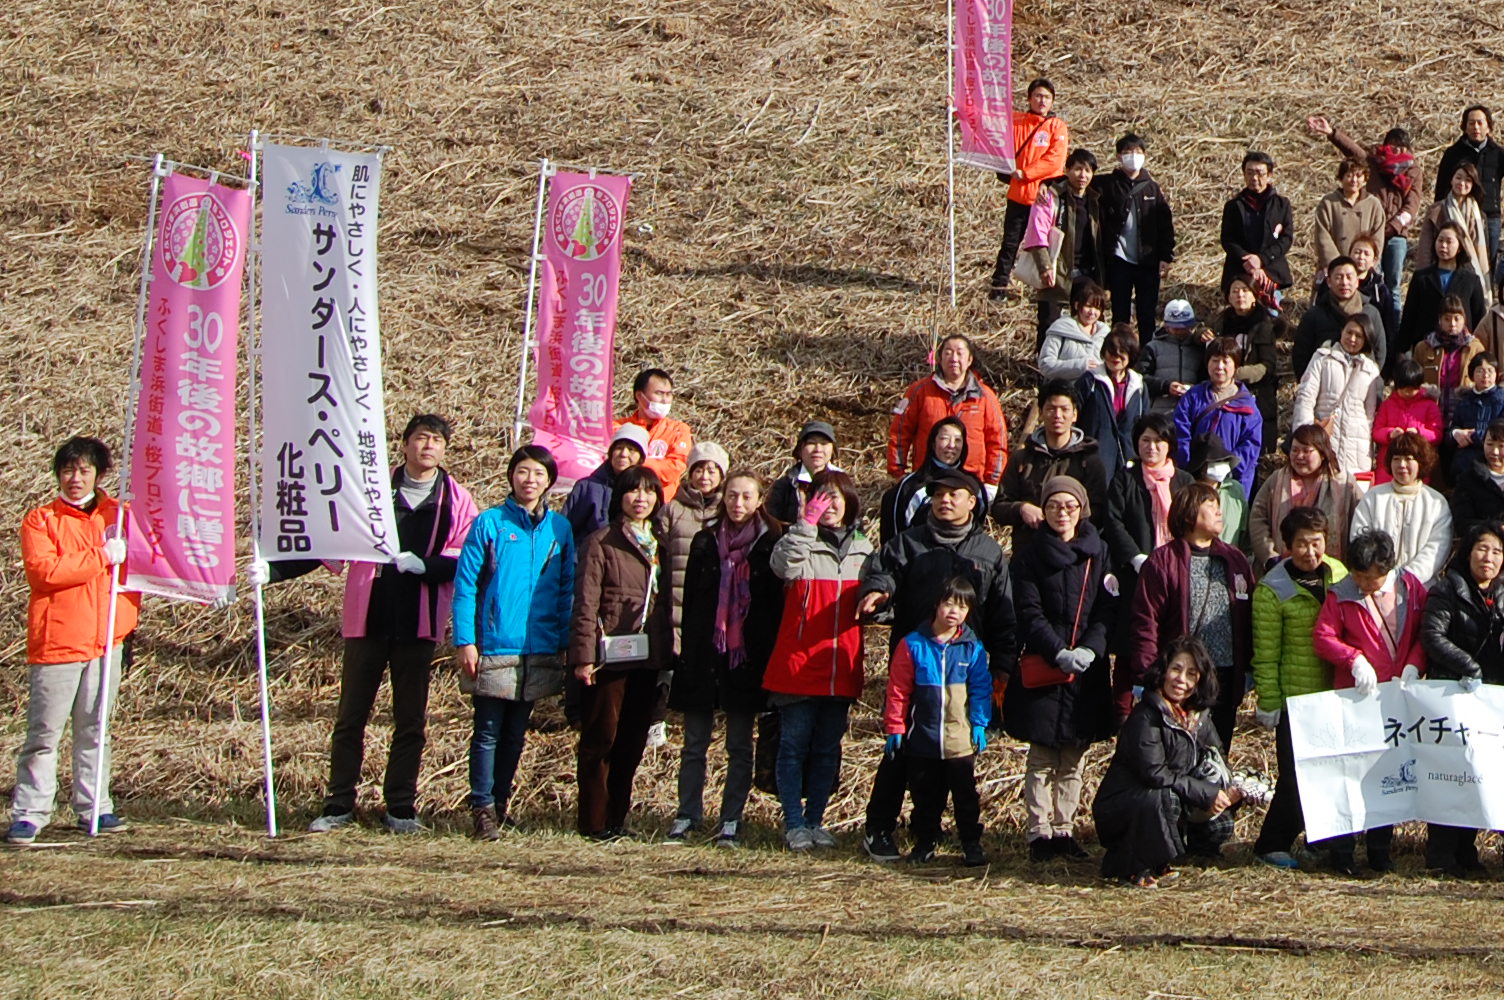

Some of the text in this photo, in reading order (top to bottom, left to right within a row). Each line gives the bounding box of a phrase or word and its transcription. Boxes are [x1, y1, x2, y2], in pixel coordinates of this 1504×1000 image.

[175, 303, 224, 569] 30年後の故郷に贈る
[276, 441, 312, 553] 化粧品
[307, 223, 344, 532] サンダース・ペリー
